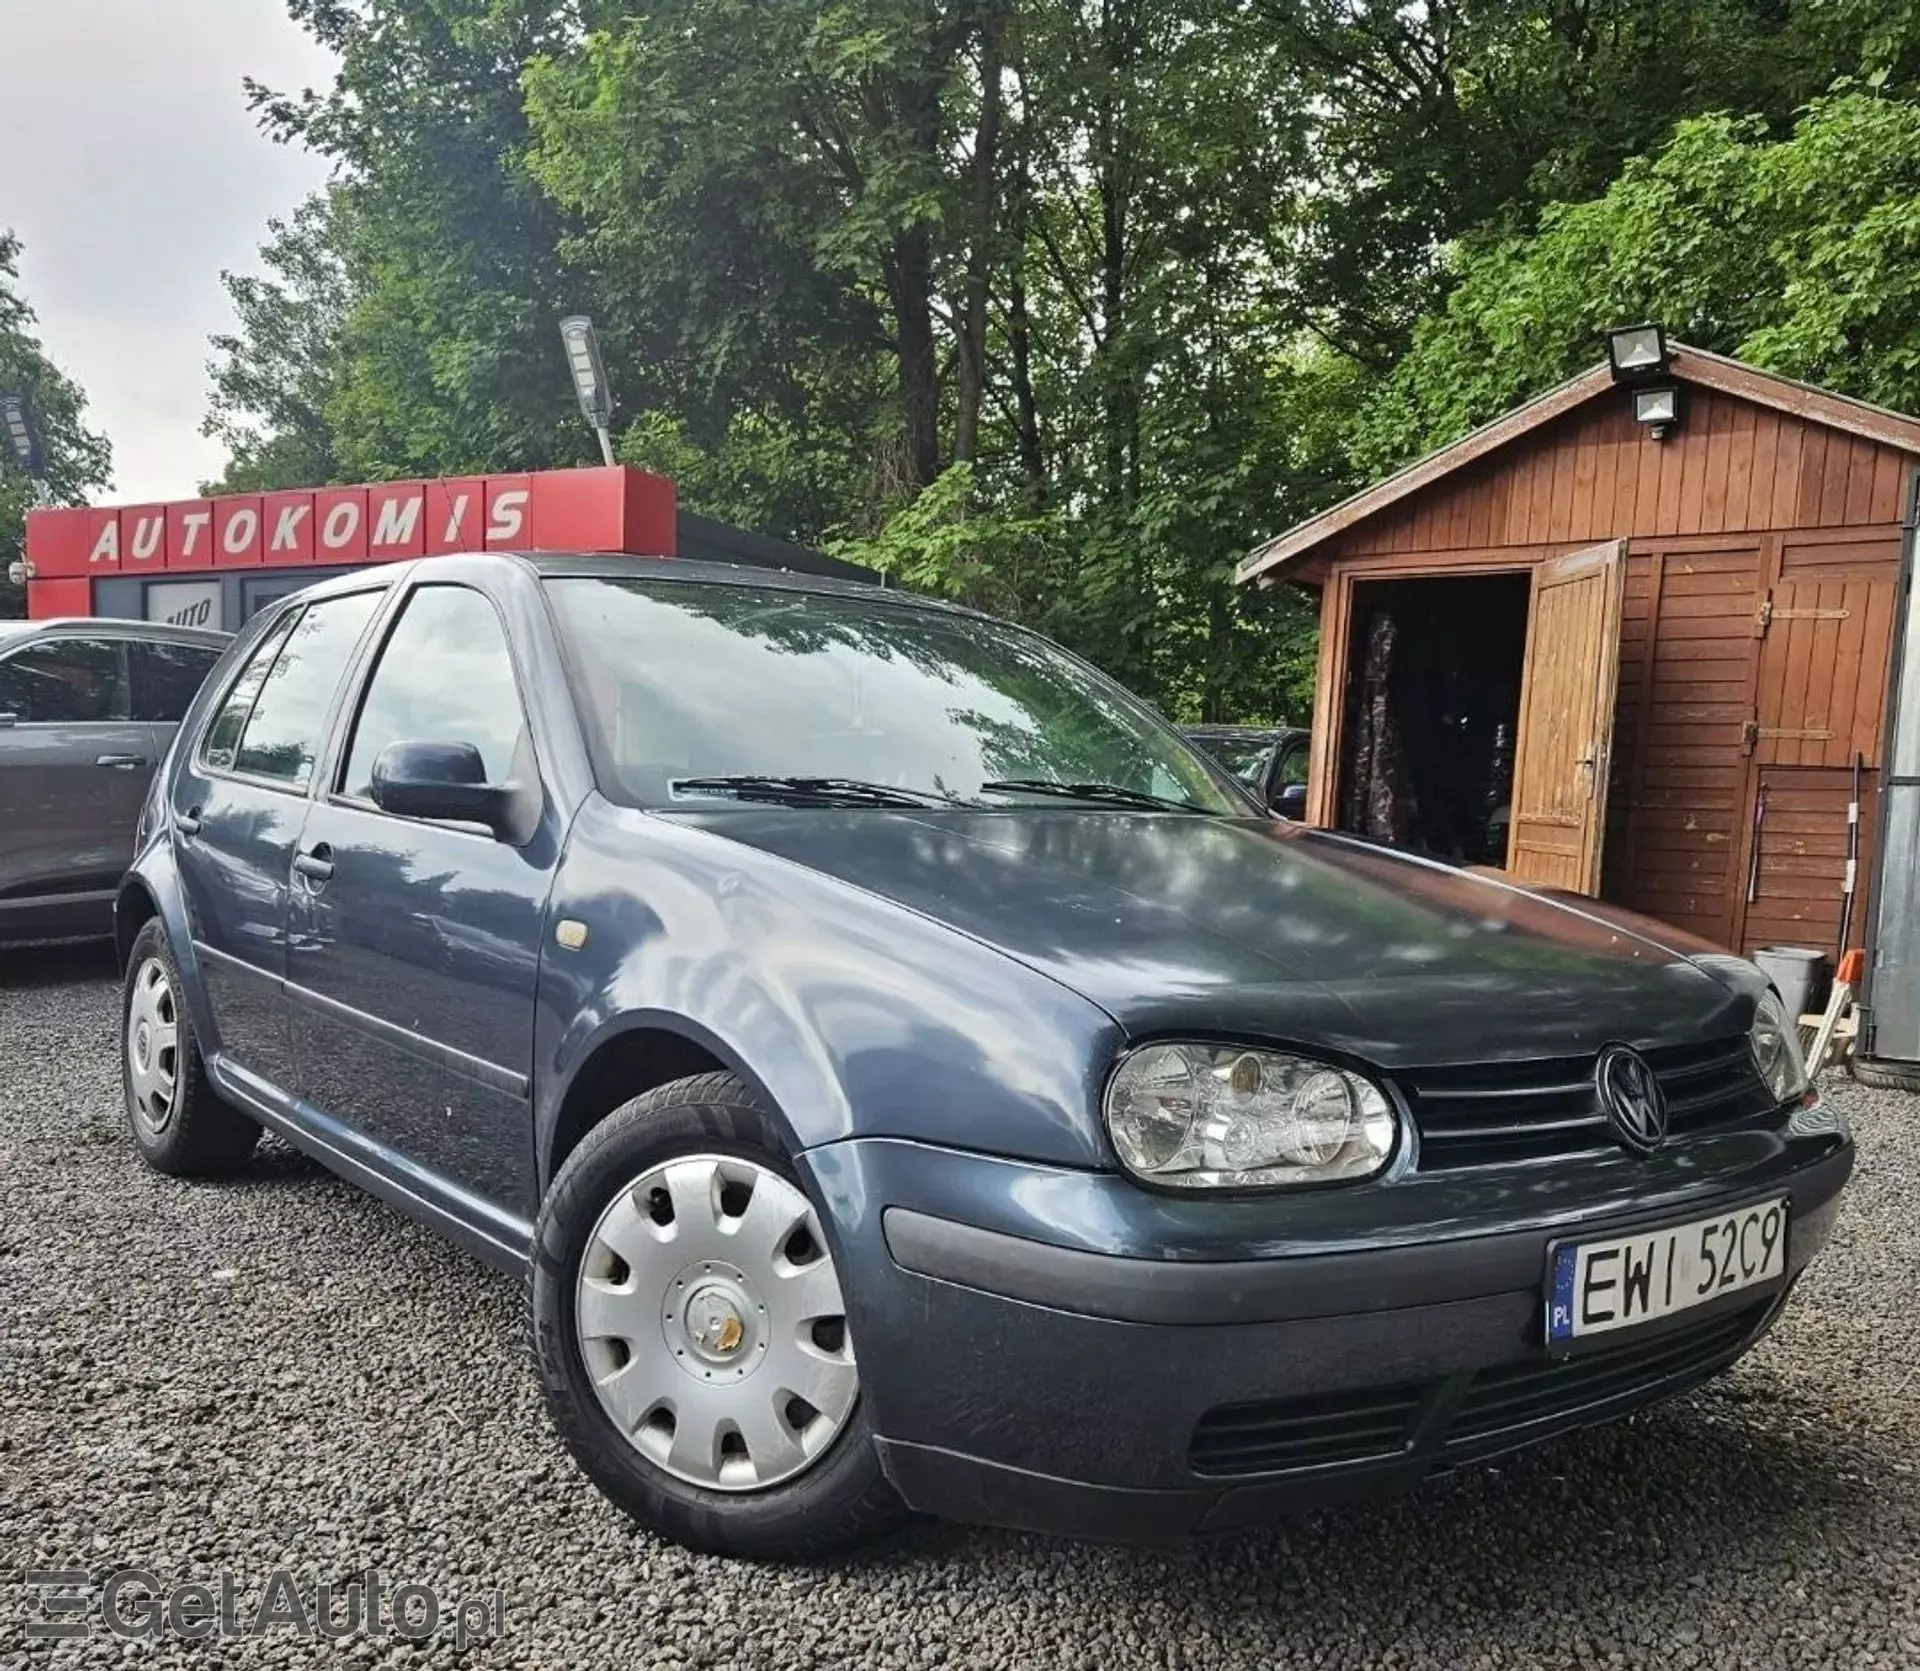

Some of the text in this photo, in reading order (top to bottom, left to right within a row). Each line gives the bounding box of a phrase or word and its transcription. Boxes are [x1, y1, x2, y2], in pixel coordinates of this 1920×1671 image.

[89, 491, 529, 562] AUTOKOMIS
[1582, 1206, 1781, 1325] EWI 52C9
[1553, 1305, 1570, 1328] PL
